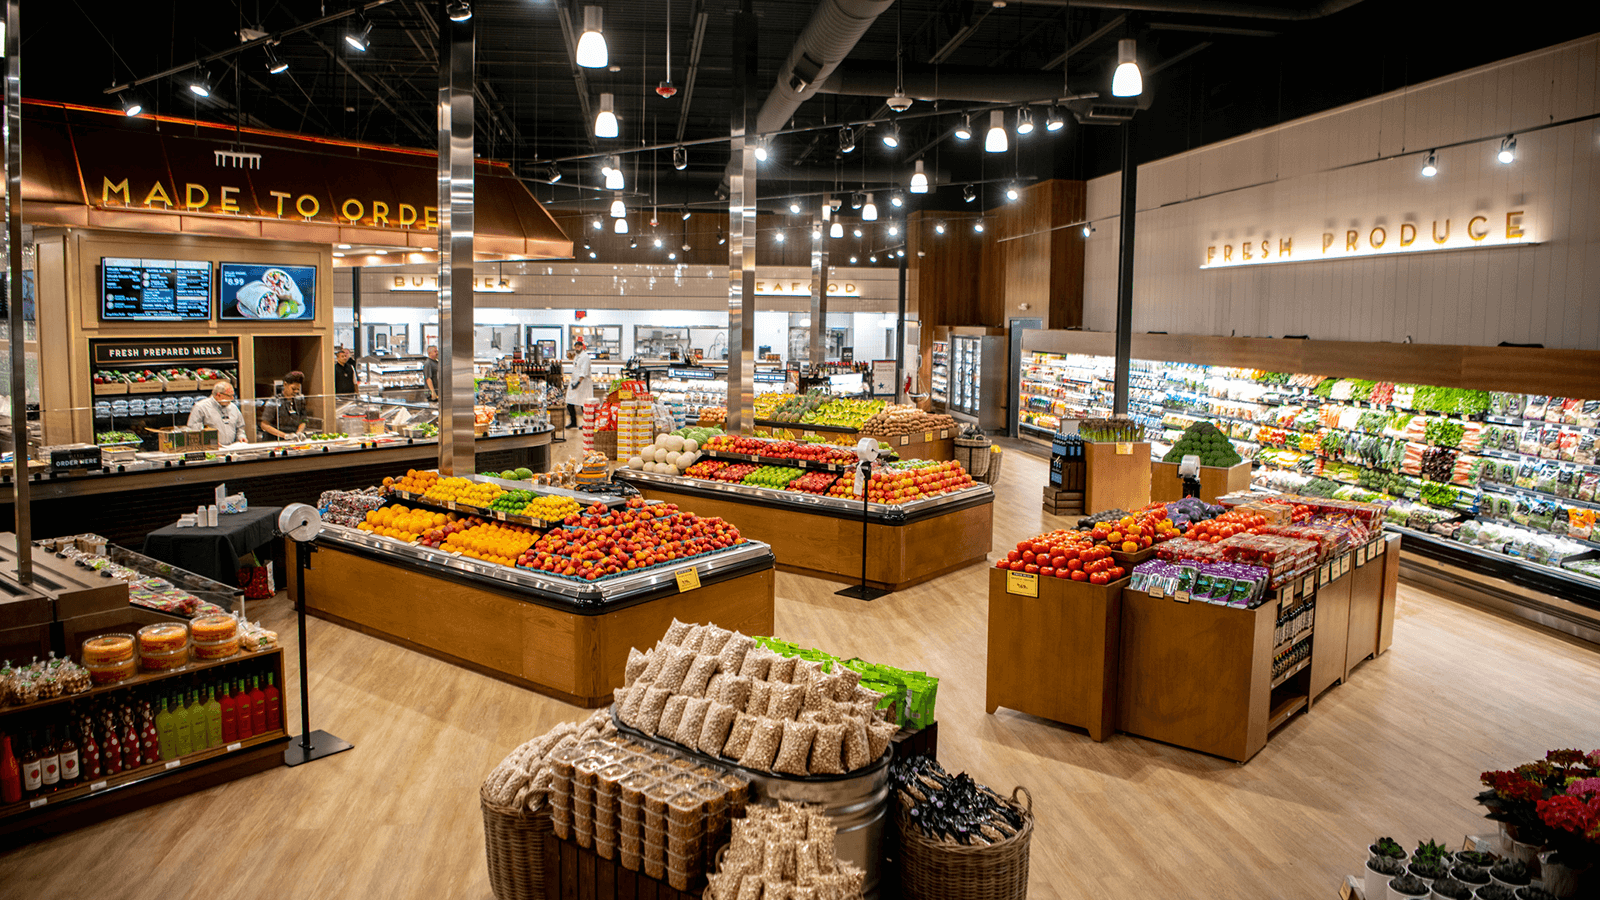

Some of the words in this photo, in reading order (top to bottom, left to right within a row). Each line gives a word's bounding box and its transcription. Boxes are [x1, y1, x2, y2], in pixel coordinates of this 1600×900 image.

[102, 176, 240, 212] MADE
[270, 190, 320, 217] TO
[342, 198, 438, 227] ORDE
[1207, 237, 1292, 264] FRESH
[1322, 211, 1524, 254] PRODUCE
[108, 348, 139, 358] FRESH
[143, 347, 190, 357] PREPARED
[192, 346, 222, 355] MEALS
